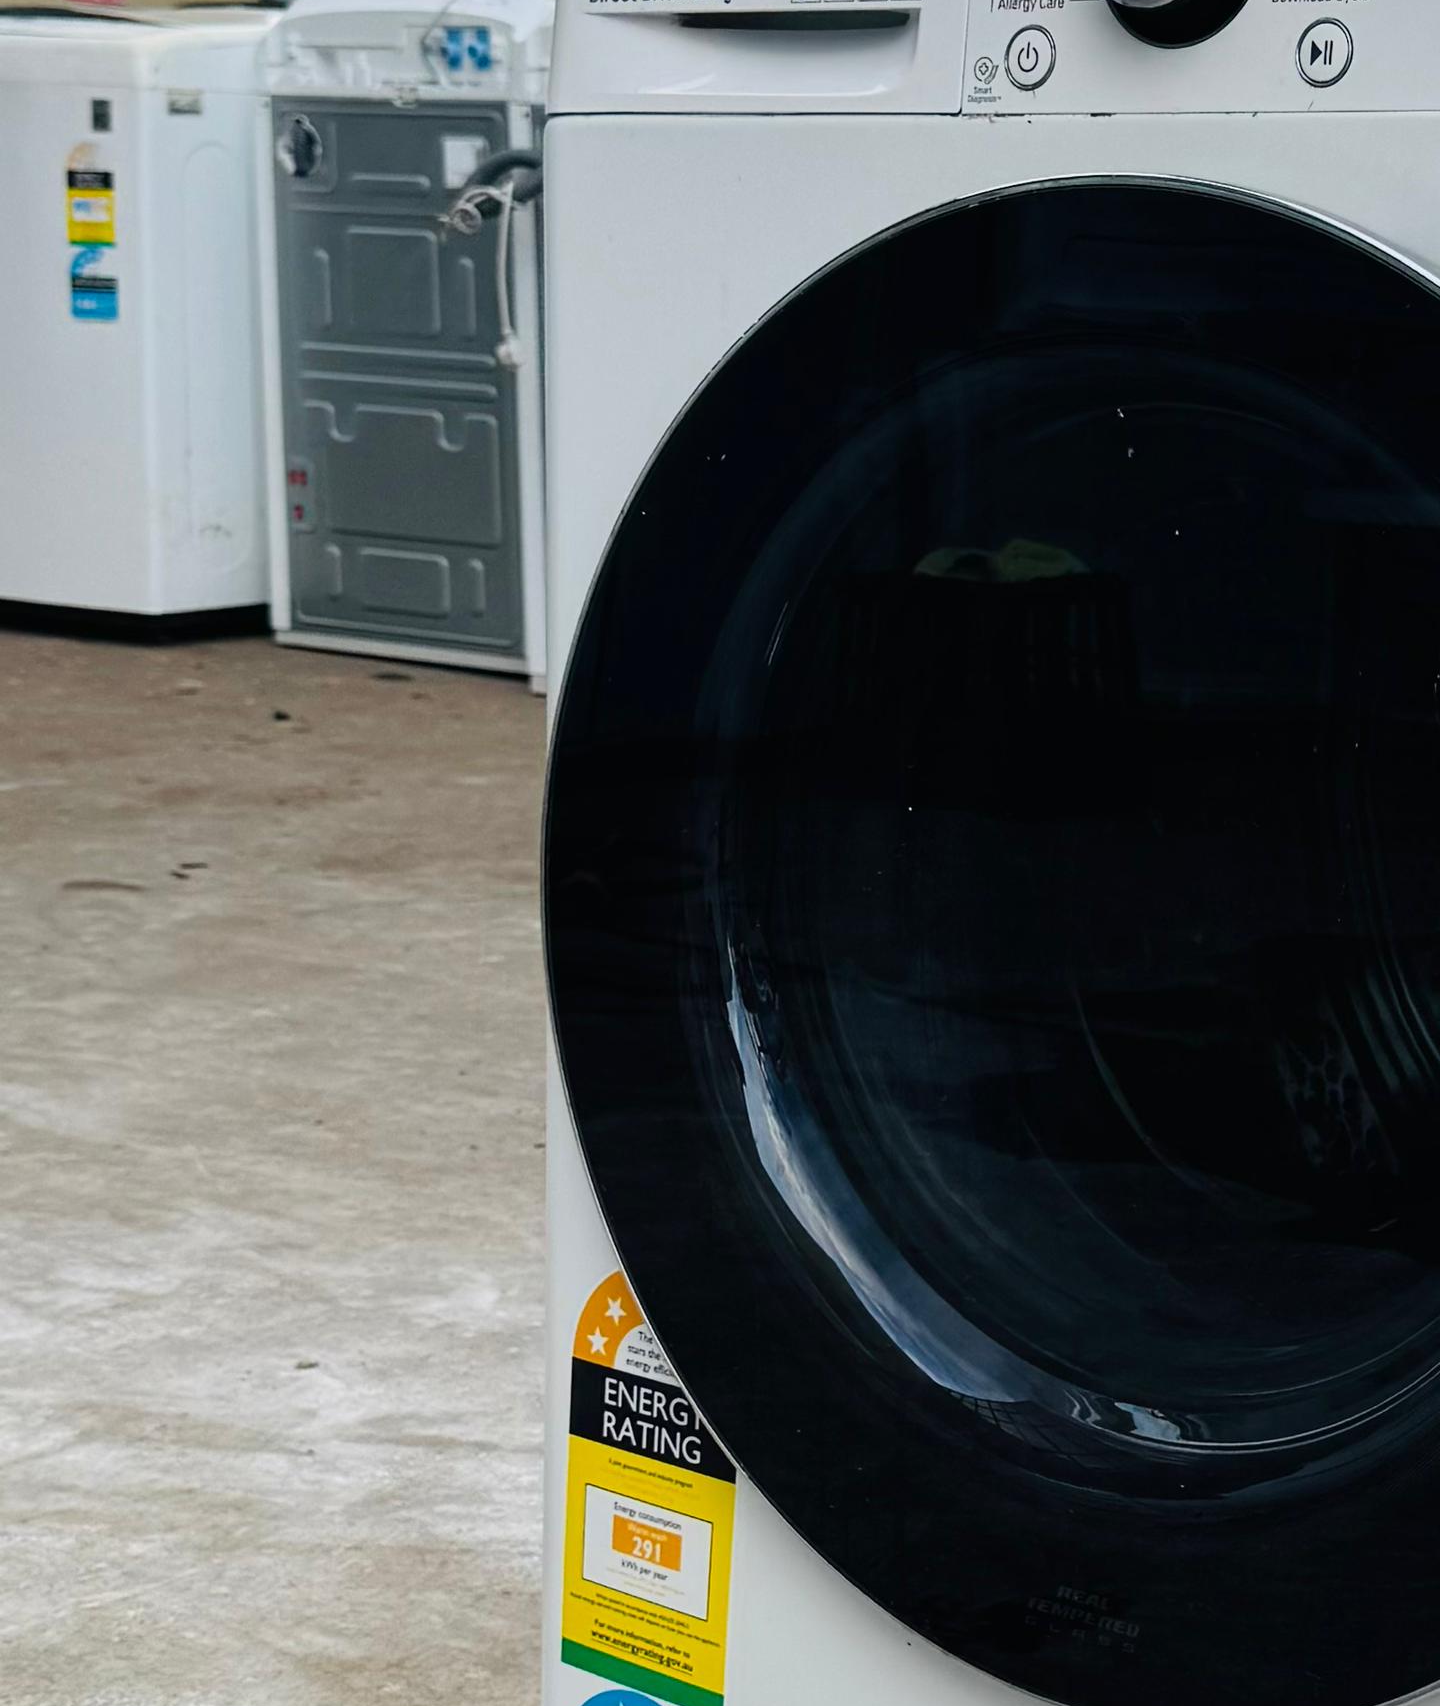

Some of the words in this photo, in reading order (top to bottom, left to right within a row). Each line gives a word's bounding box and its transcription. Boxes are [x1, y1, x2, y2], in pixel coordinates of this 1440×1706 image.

[638, 1330, 653, 1345] The
[603, 1410, 702, 1465] RATING
[614, 1501, 637, 1518] Energy
[638, 1511, 682, 1531] consumption
[631, 1536, 662, 1563] 291
[640, 1566, 651, 1576] per
[653, 1570, 669, 1581] year
